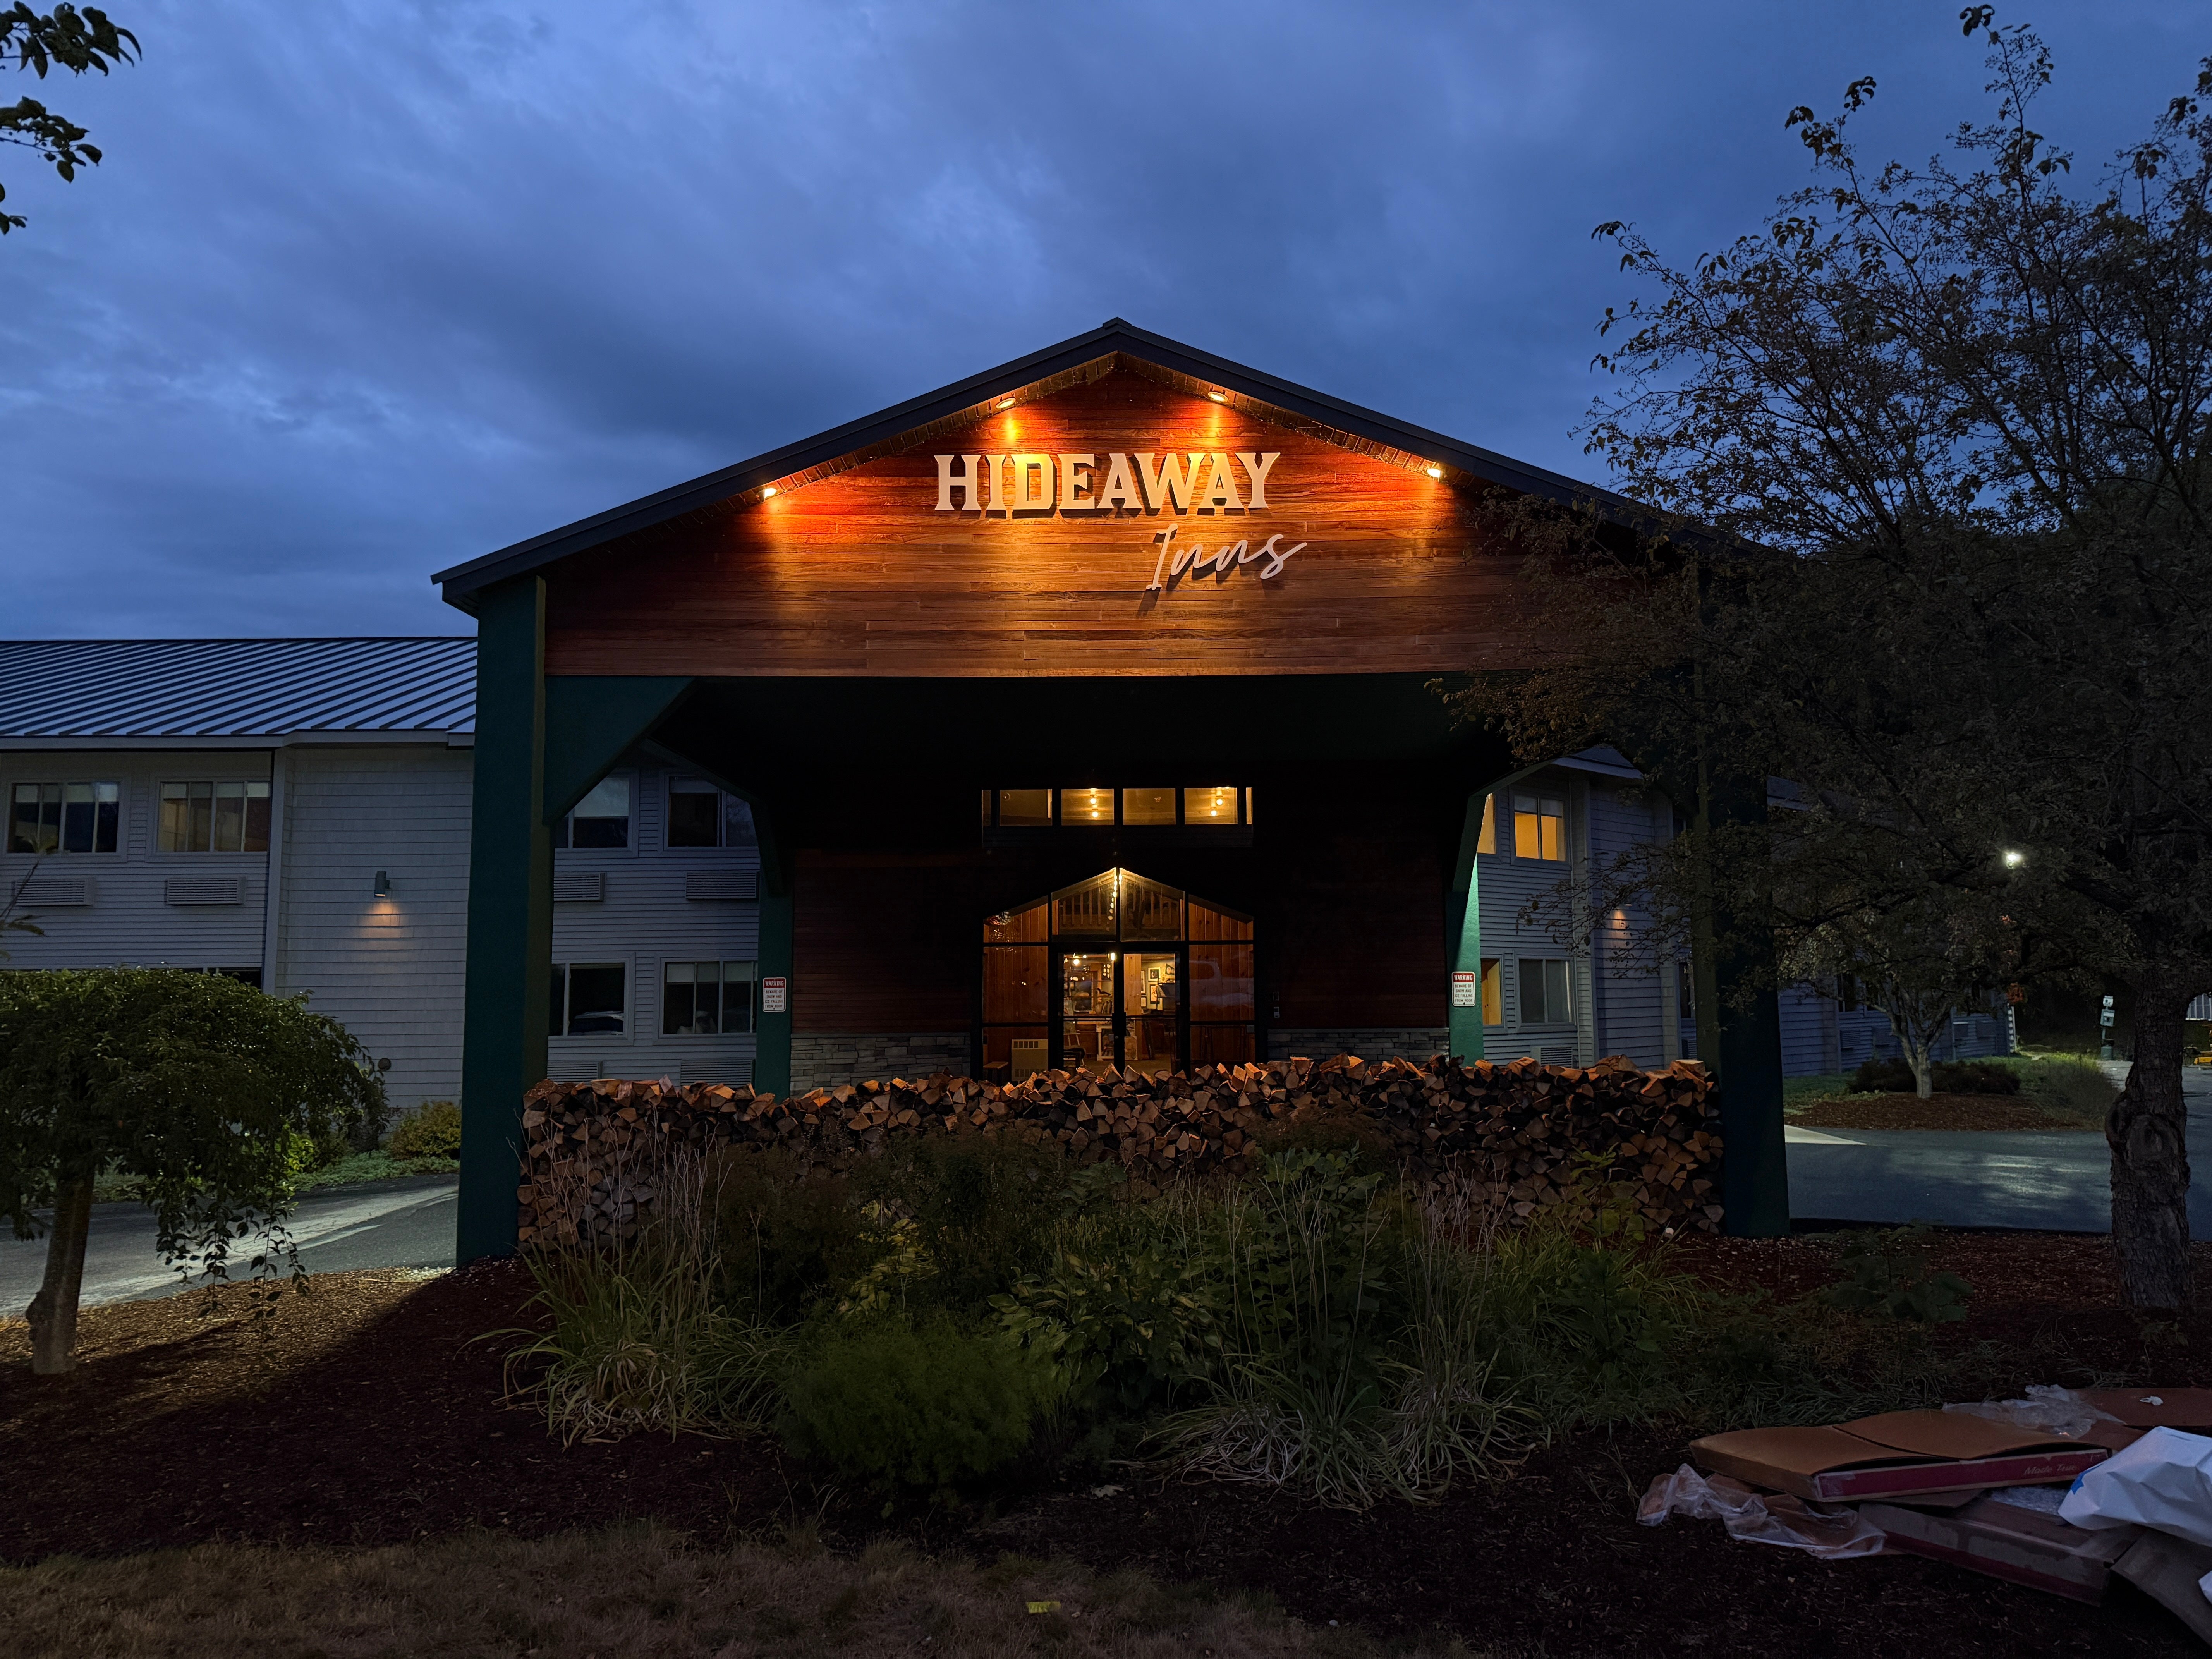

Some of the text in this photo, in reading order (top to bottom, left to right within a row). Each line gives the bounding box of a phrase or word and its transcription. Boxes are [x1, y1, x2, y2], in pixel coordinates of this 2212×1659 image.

[934, 452, 1281, 511] HIDEAWAY
[1146, 524, 1307, 591] Inns
[2023, 1465, 2052, 1475] Made
